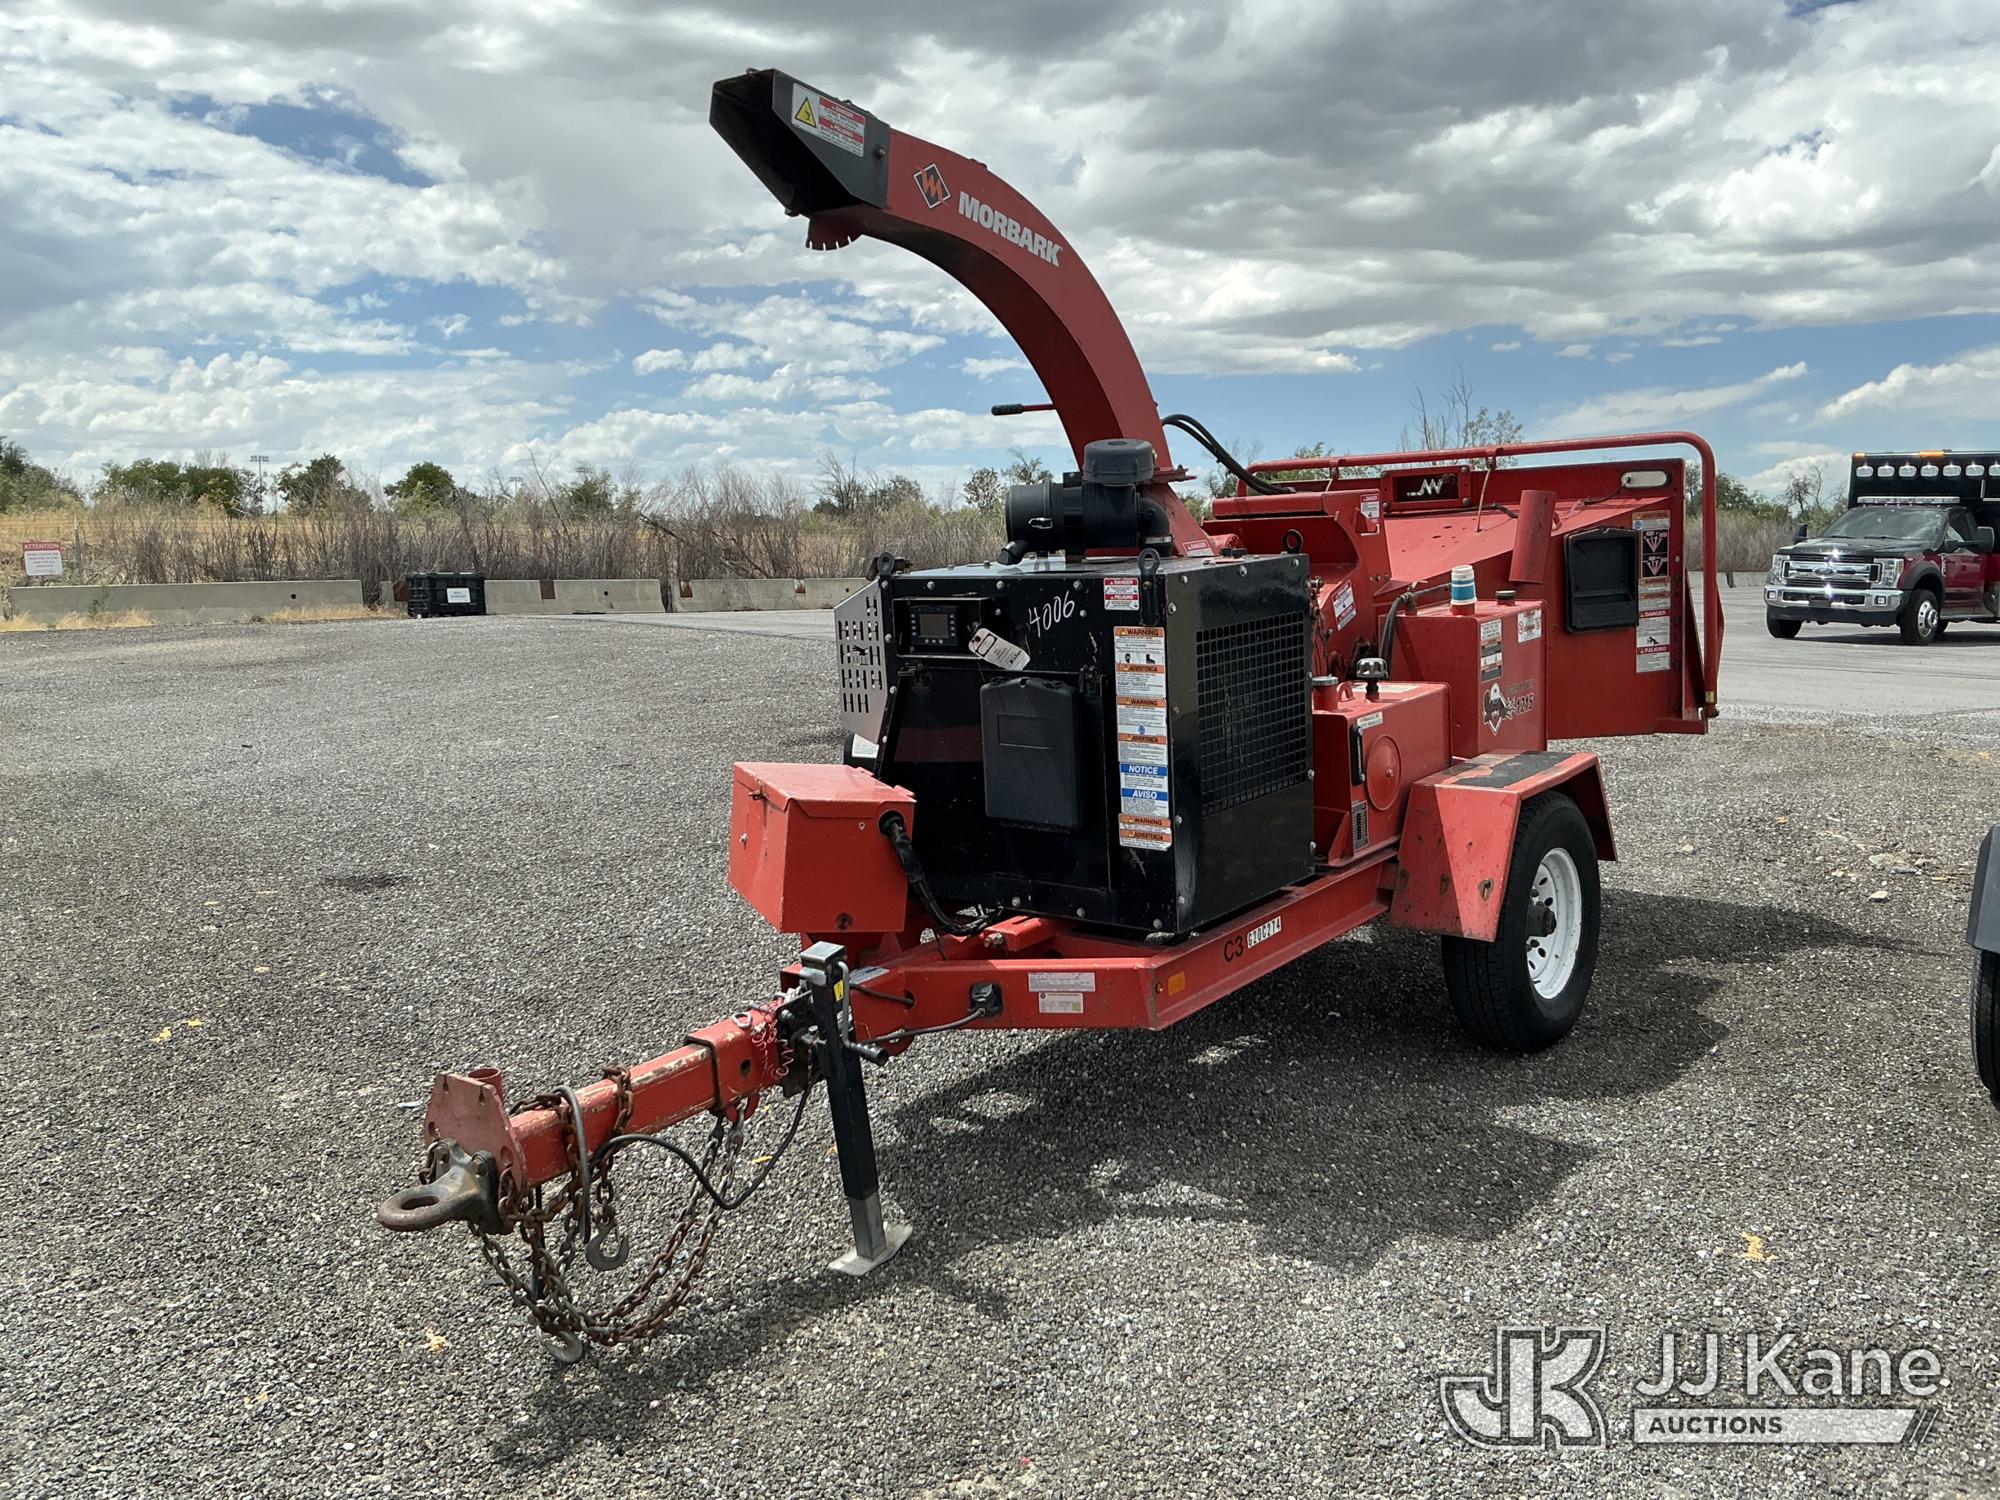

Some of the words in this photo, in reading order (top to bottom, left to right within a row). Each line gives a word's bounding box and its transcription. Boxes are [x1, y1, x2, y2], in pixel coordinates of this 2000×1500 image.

[958, 190, 1063, 268] MORBARK
[1028, 590, 1075, 638] 4006
[1127, 628, 1159, 636] WARNING
[1131, 698, 1158, 706] WARNING
[1128, 765, 1159, 775] NOTICE
[1132, 789, 1158, 800] AVISO
[1134, 818, 1163, 826] WARNING
[1224, 935, 1244, 962] C3
